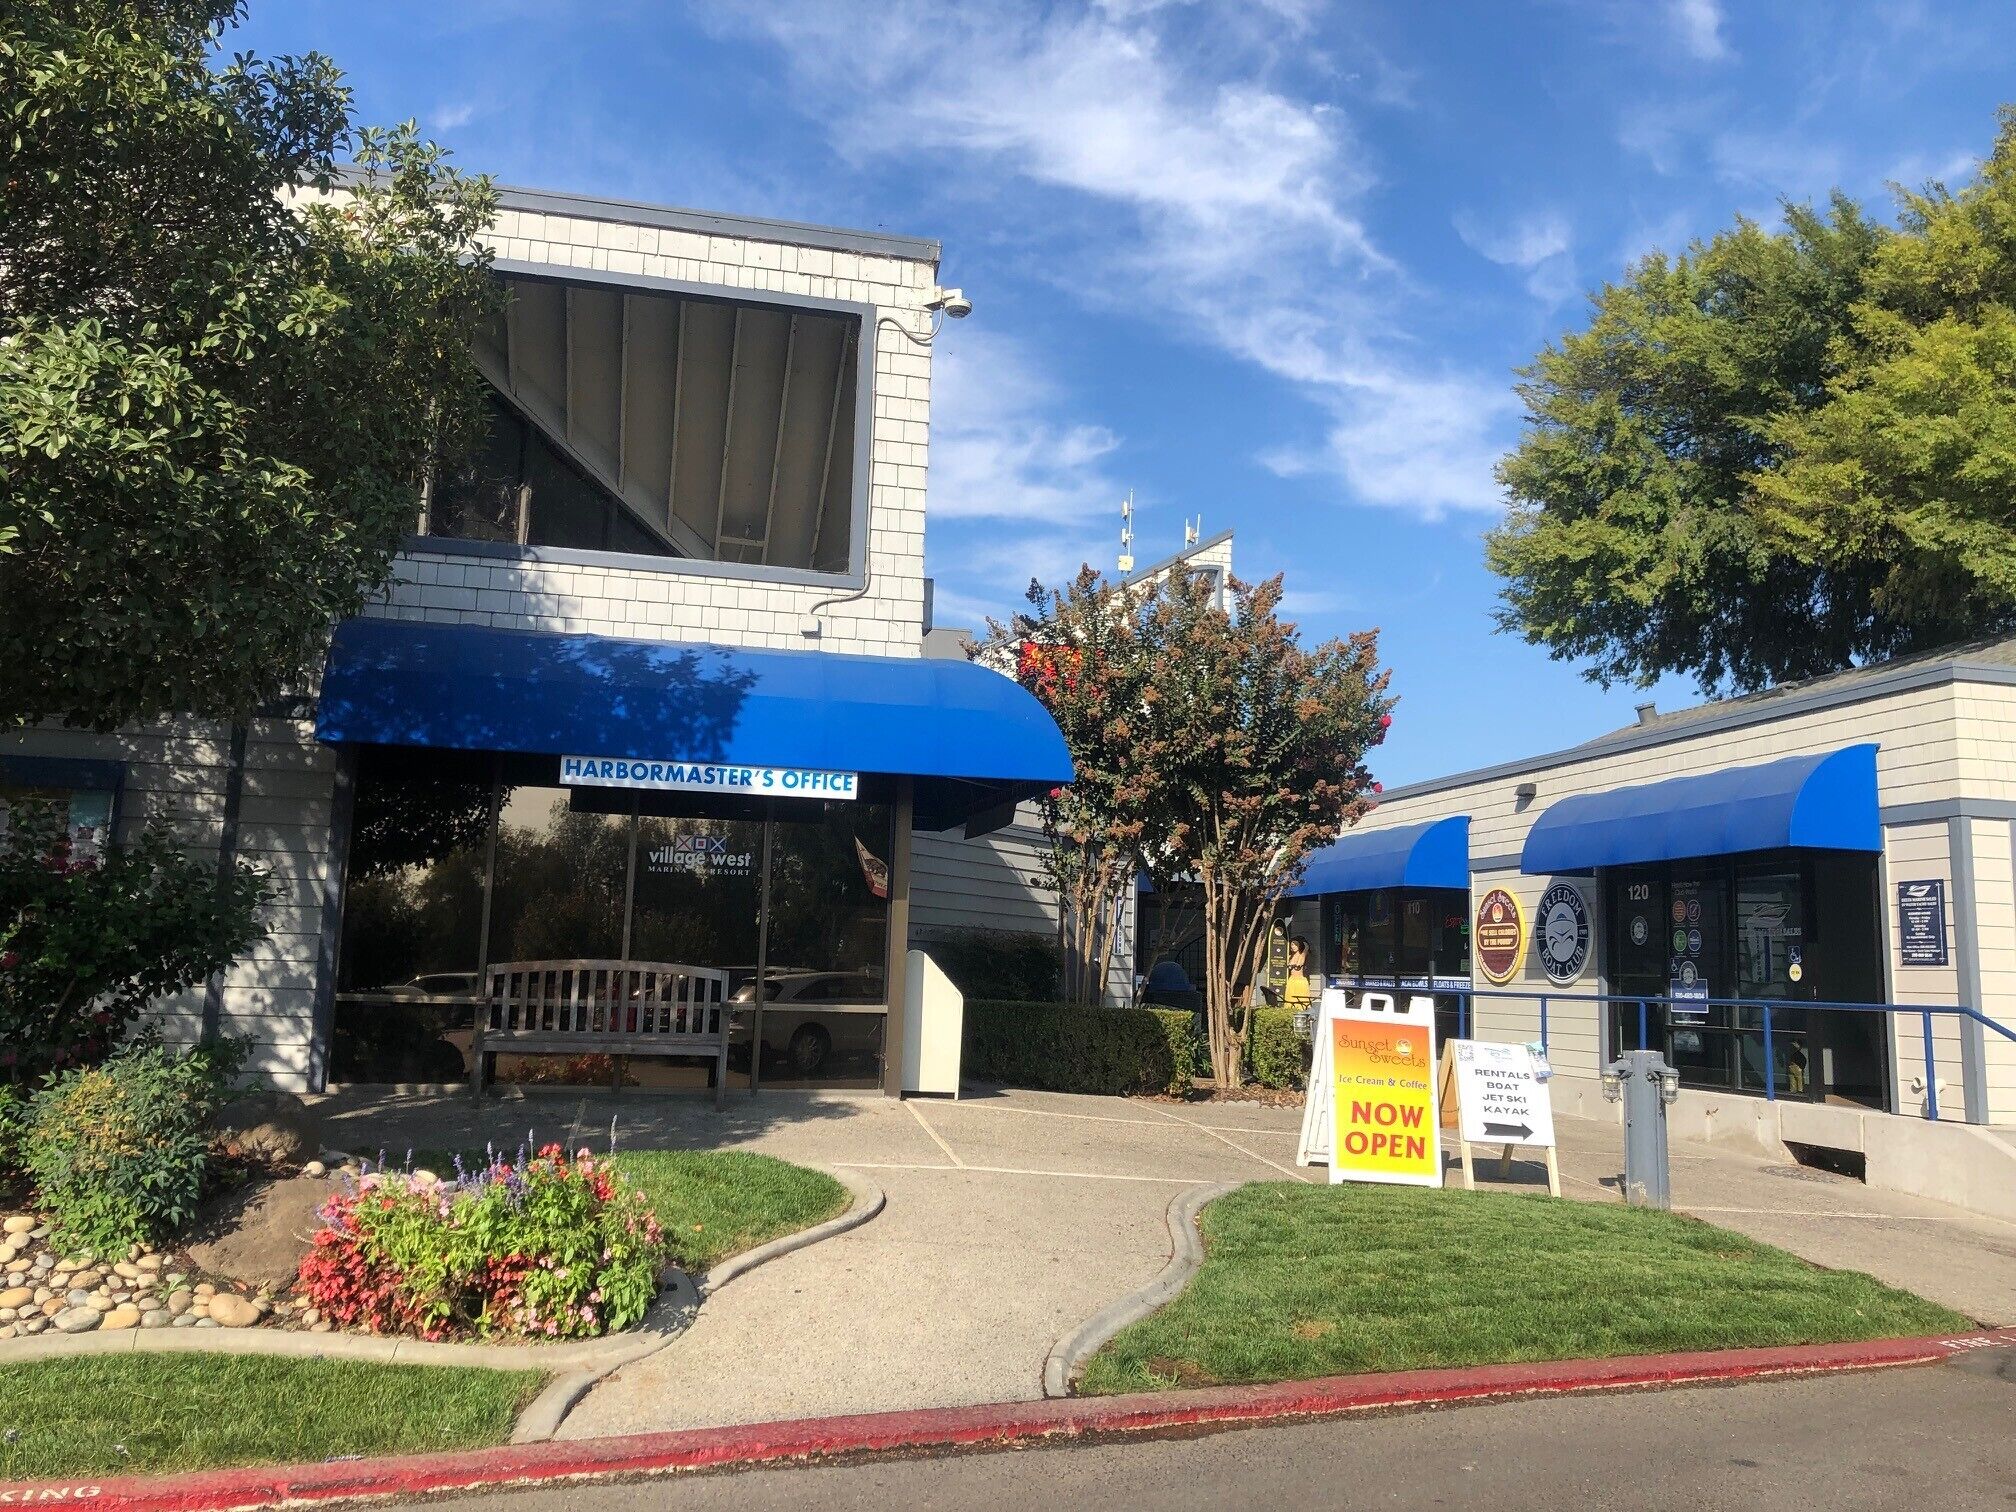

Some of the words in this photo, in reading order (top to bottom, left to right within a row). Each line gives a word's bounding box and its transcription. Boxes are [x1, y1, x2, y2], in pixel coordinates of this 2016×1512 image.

[565, 758, 774, 788] HARBORMASTER'S
[781, 769, 852, 792] OFFICE
[649, 846, 706, 869] village
[711, 852, 751, 867] west
[648, 866, 687, 874] MARINA
[710, 868, 750, 876] RESORT
[1628, 884, 1649, 900] 120
[1541, 889, 1582, 918] FREEDOM
[1541, 947, 1561, 976] BOAT
[1565, 945, 1585, 975] CLUB
[1433, 980, 1450, 989] FLOATS
[1339, 1035, 1392, 1055] Sunset
[1369, 1049, 1426, 1068] Sweets
[1339, 1074, 1352, 1083] Ice
[1355, 1075, 1384, 1085] Cream
[1388, 1078, 1396, 1087] &
[1399, 1079, 1428, 1090] Coffee
[1475, 1068, 1531, 1080] RENTALS
[1486, 1081, 1520, 1091] BOAT
[1482, 1093, 1504, 1102] JET
[1506, 1095, 1527, 1104] SKI
[1351, 1100, 1424, 1128] NOW
[1483, 1105, 1530, 1116] KAYAK
[1345, 1131, 1426, 1160] OPEN
